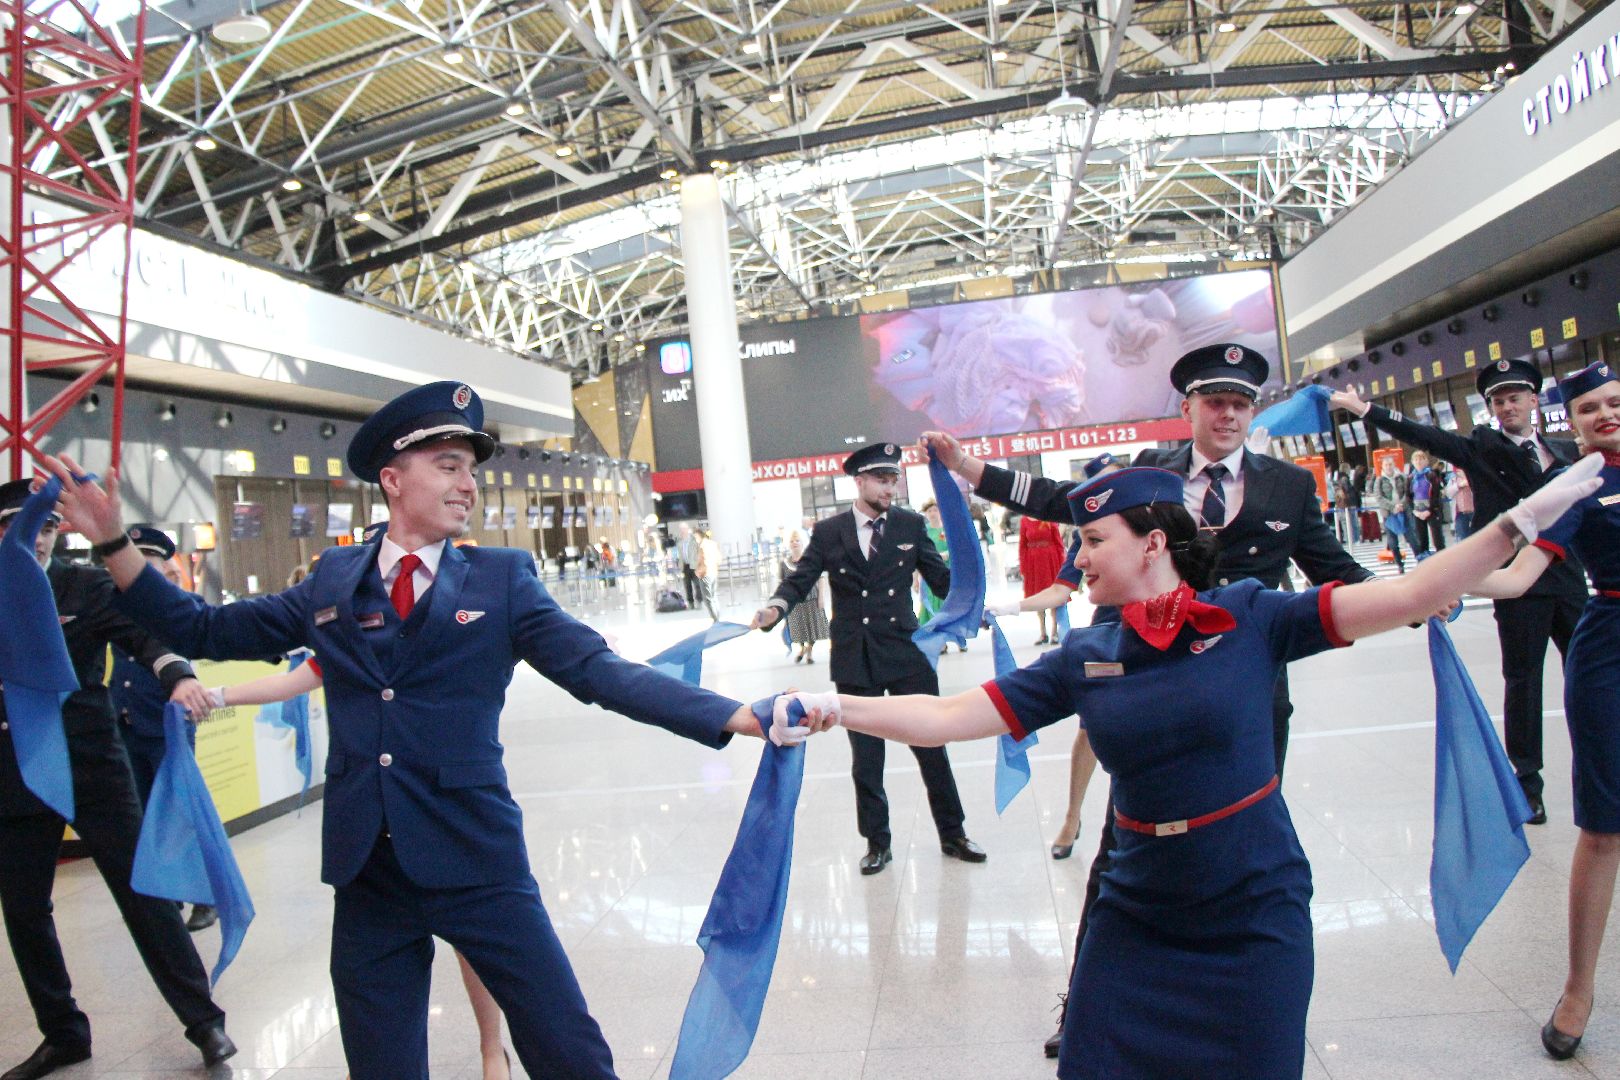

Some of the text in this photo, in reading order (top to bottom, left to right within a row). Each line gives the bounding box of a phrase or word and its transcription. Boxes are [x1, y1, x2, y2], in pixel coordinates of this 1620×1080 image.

[962, 427, 1138, 457] TES 登机口 101-123
[752, 461, 811, 479] ЫХОДЫ
[815, 457, 838, 473] НА
